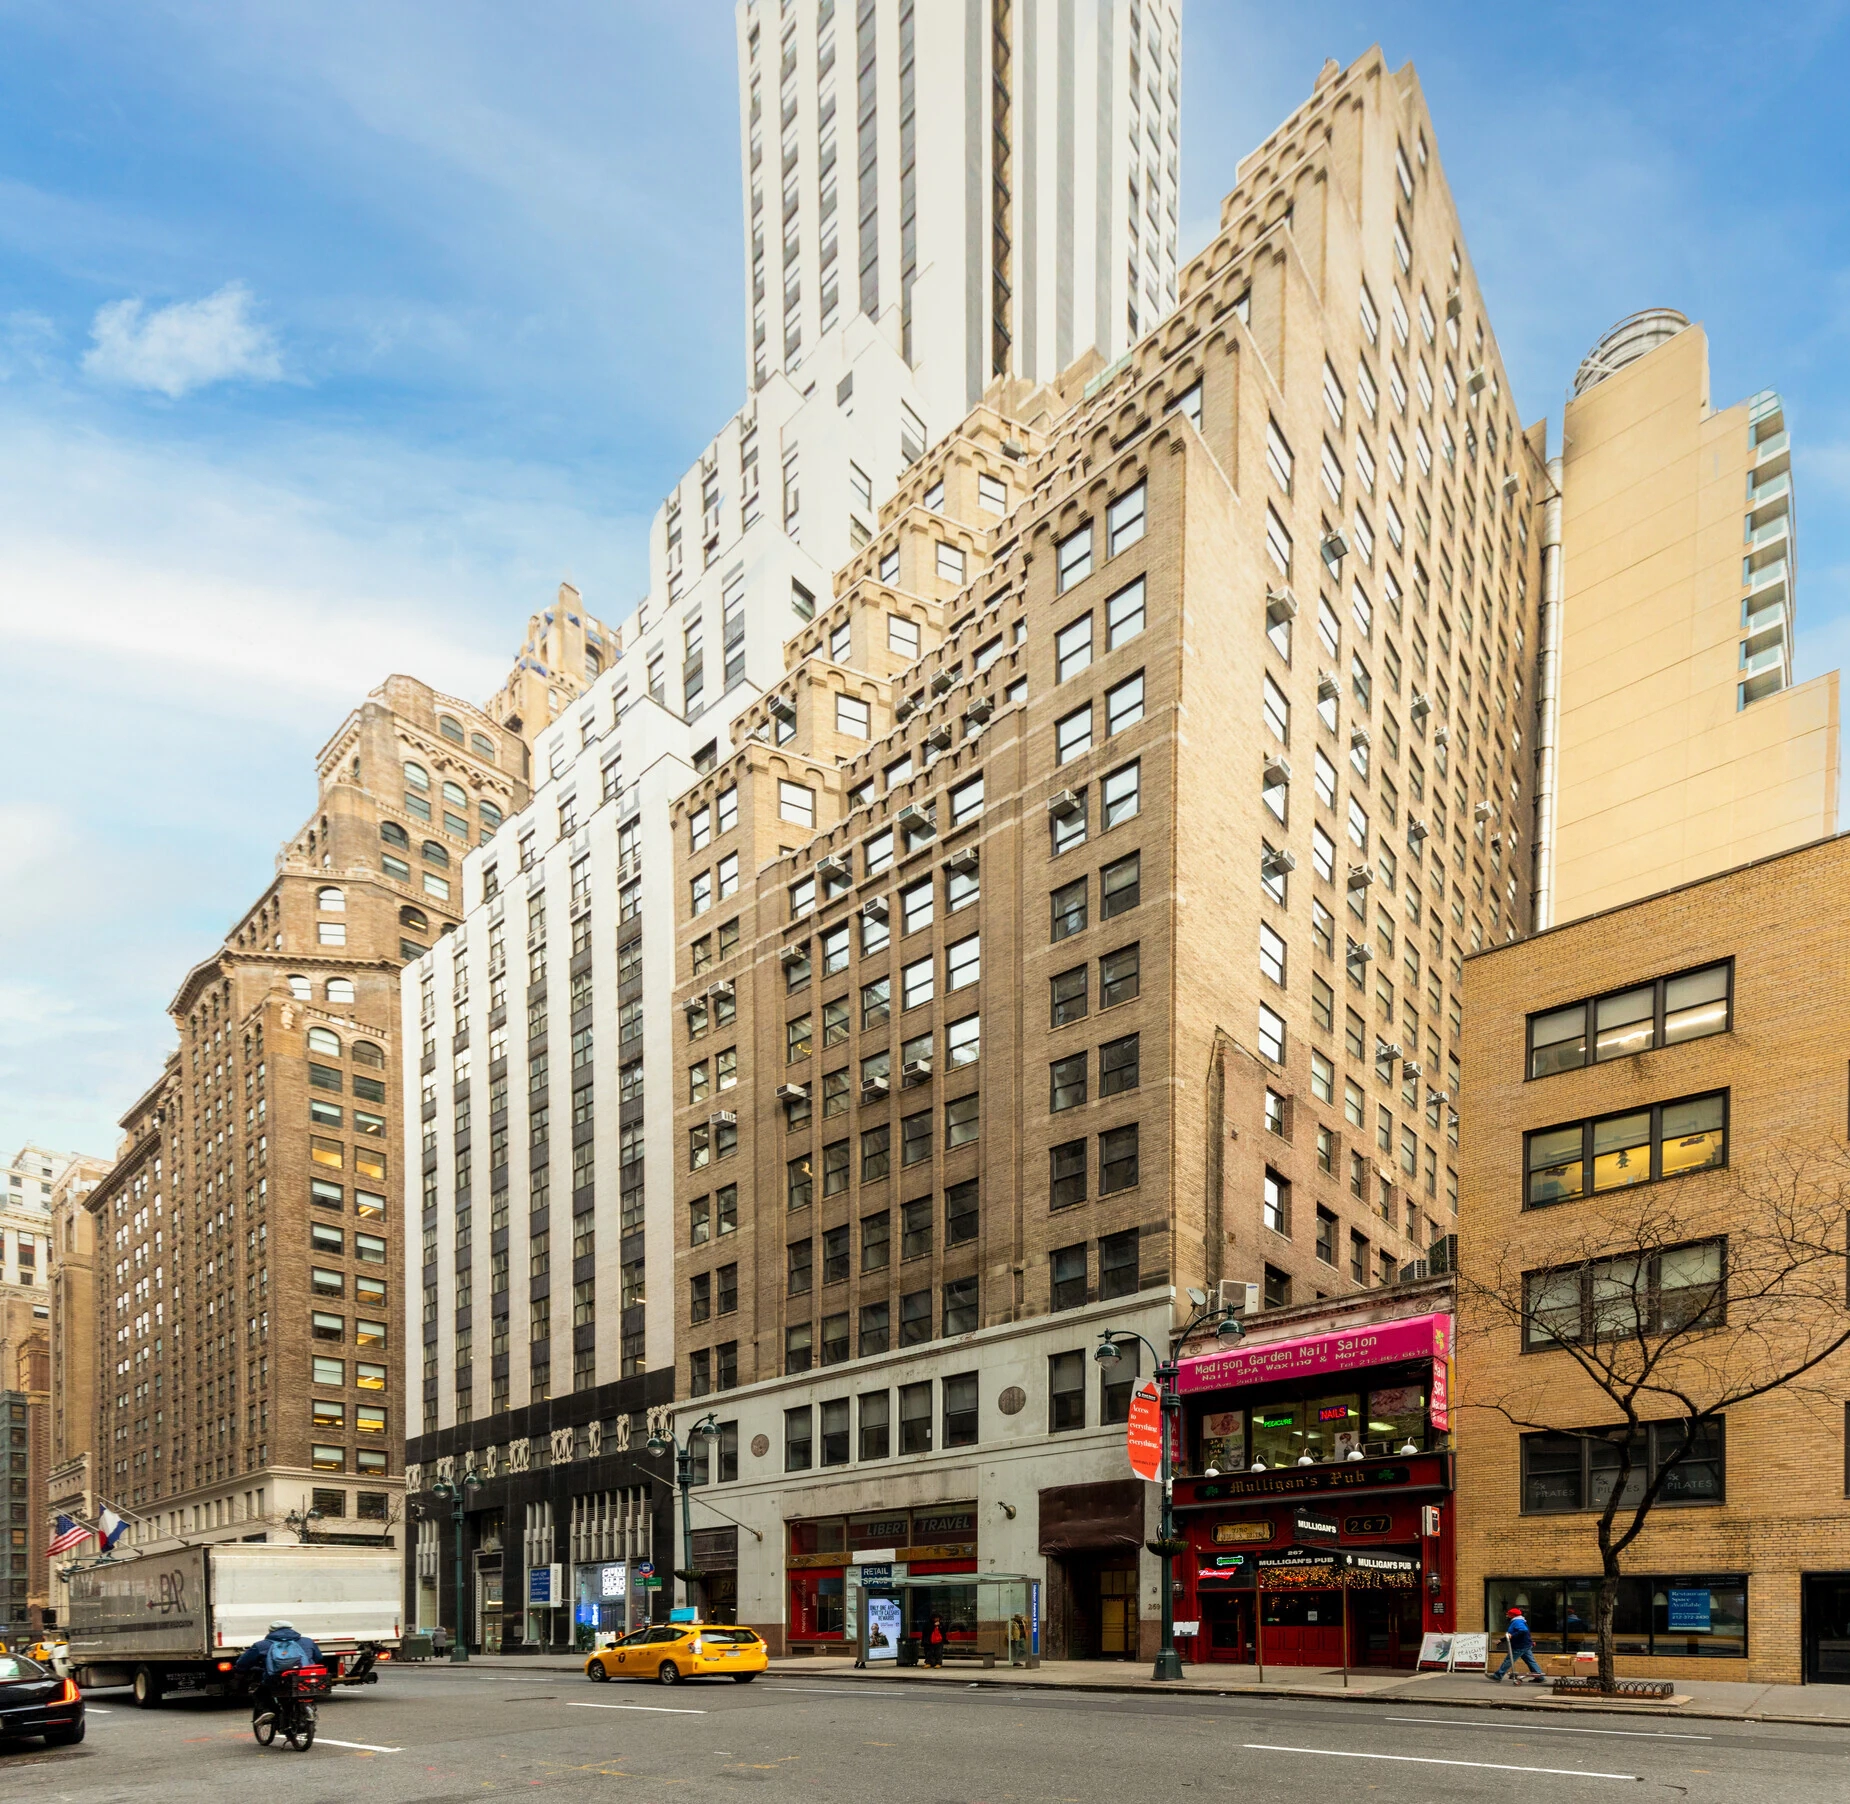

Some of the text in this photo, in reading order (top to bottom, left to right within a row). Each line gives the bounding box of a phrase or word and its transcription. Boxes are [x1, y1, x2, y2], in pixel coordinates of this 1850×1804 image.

[1195, 1336, 1377, 1375] Madison Garden Nail Salon
[1202, 1371, 1228, 1381] Nail
[1237, 1367, 1259, 1376] SPA
[1265, 1359, 1312, 1371] Waxing
[1335, 1350, 1369, 1360] More
[1434, 1380, 1444, 1397] SPA
[1132, 1404, 1149, 1414] Access
[1320, 1407, 1347, 1420] NAILS
[1129, 1423, 1158, 1433] everything
[1263, 1418, 1293, 1428] PEDICURE
[1128, 1439, 1159, 1449] everything.
[1229, 1470, 1365, 1494] Mulligan's Pub
[1667, 1479, 1713, 1490] PILATES
[1535, 1488, 1576, 1498] PILATES
[1597, 1484, 1640, 1494] PILES
[922, 1515, 970, 1532] TRAVEL
[1297, 1519, 1337, 1534] MULLIGAN'S
[1350, 1518, 1386, 1532] 267
[1258, 1557, 1313, 1566] MULLIGAN'S
[1357, 1557, 1412, 1570] MULLIGAN'S PUB
[863, 1567, 888, 1575] RETAIL
